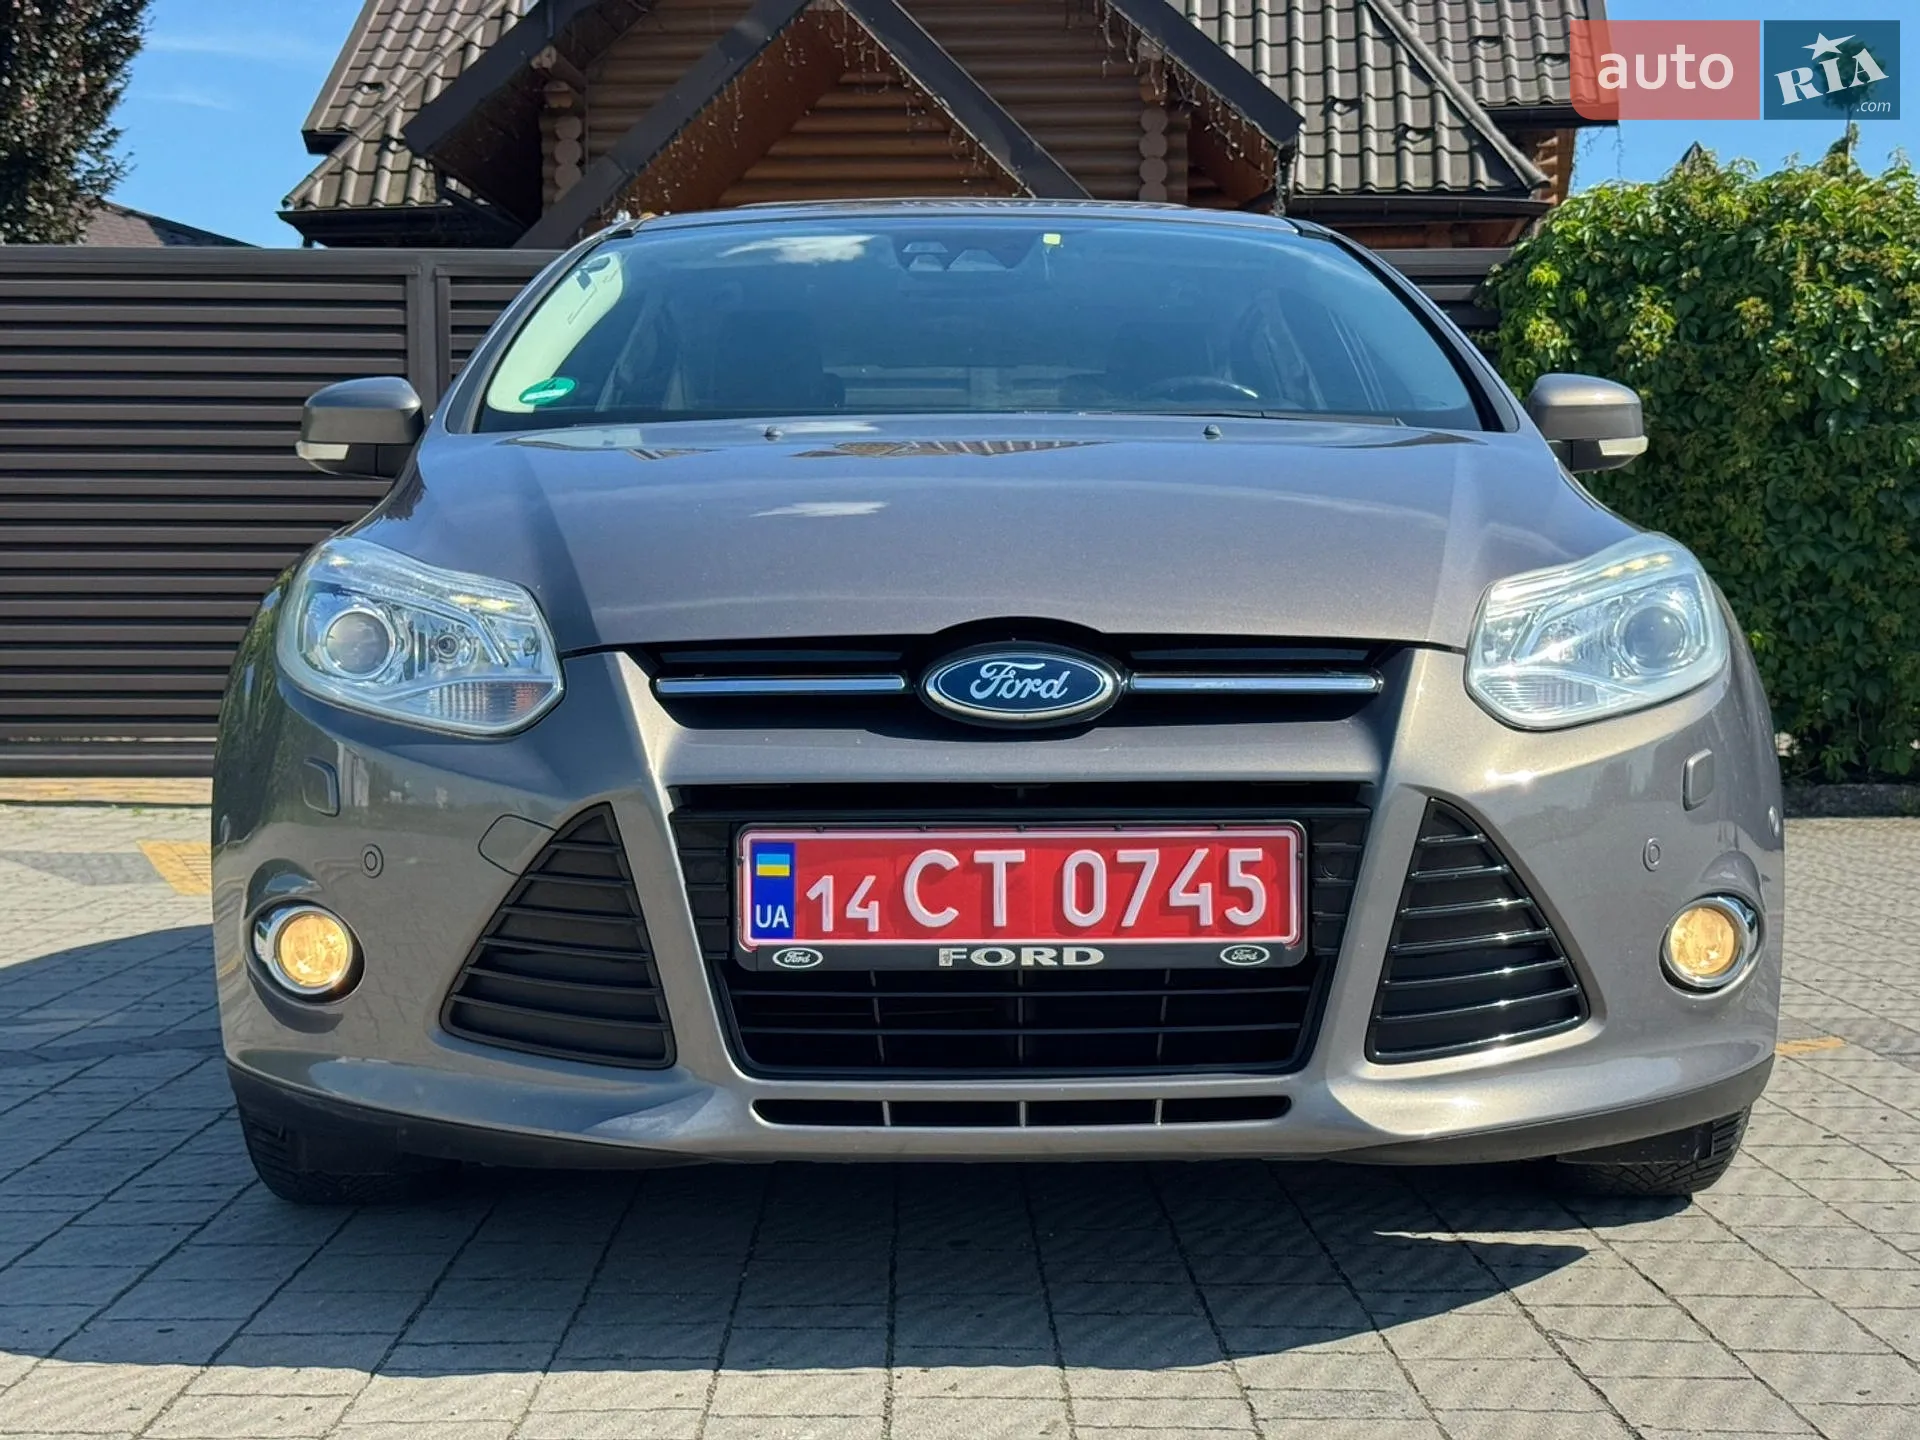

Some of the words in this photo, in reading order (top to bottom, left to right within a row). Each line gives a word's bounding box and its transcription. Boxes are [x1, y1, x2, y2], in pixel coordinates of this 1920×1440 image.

[969, 661, 1071, 700] Ford
[806, 874, 880, 932] 14
[903, 849, 1026, 928] CT
[1062, 848, 1267, 928] 0745
[755, 904, 790, 928] UA
[784, 950, 811, 963] Ford
[938, 947, 1104, 967] FORD
[1231, 948, 1258, 961] Ford
